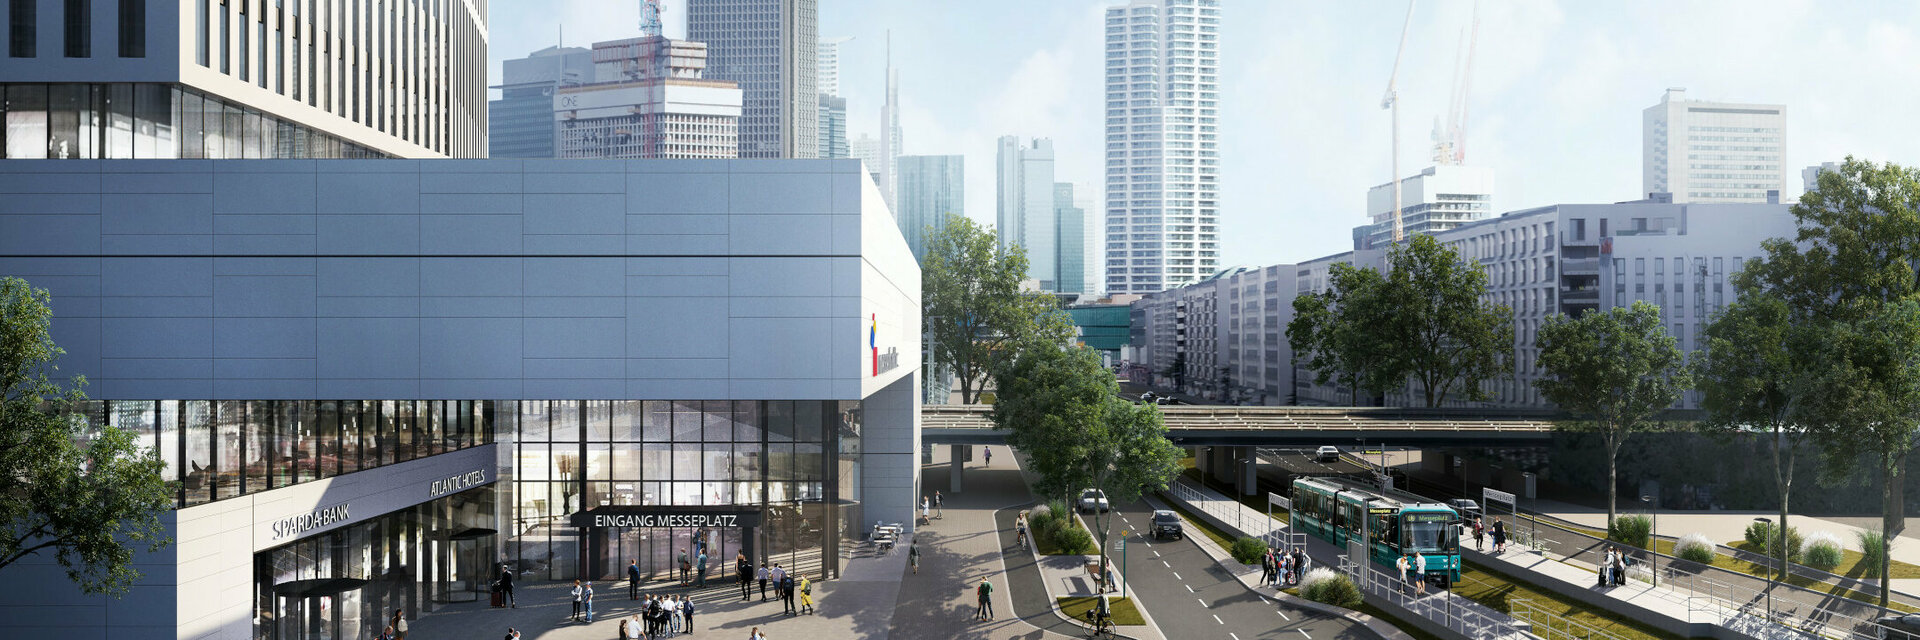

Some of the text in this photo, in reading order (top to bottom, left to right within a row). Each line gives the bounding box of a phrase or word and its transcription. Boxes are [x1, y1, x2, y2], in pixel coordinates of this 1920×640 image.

[562, 96, 577, 107] ONE
[430, 469, 485, 498] ATLANTIC HOTELS
[272, 504, 350, 540] SPARDA-BANK
[595, 515, 737, 527] EINGANG MESSEPLATZ
